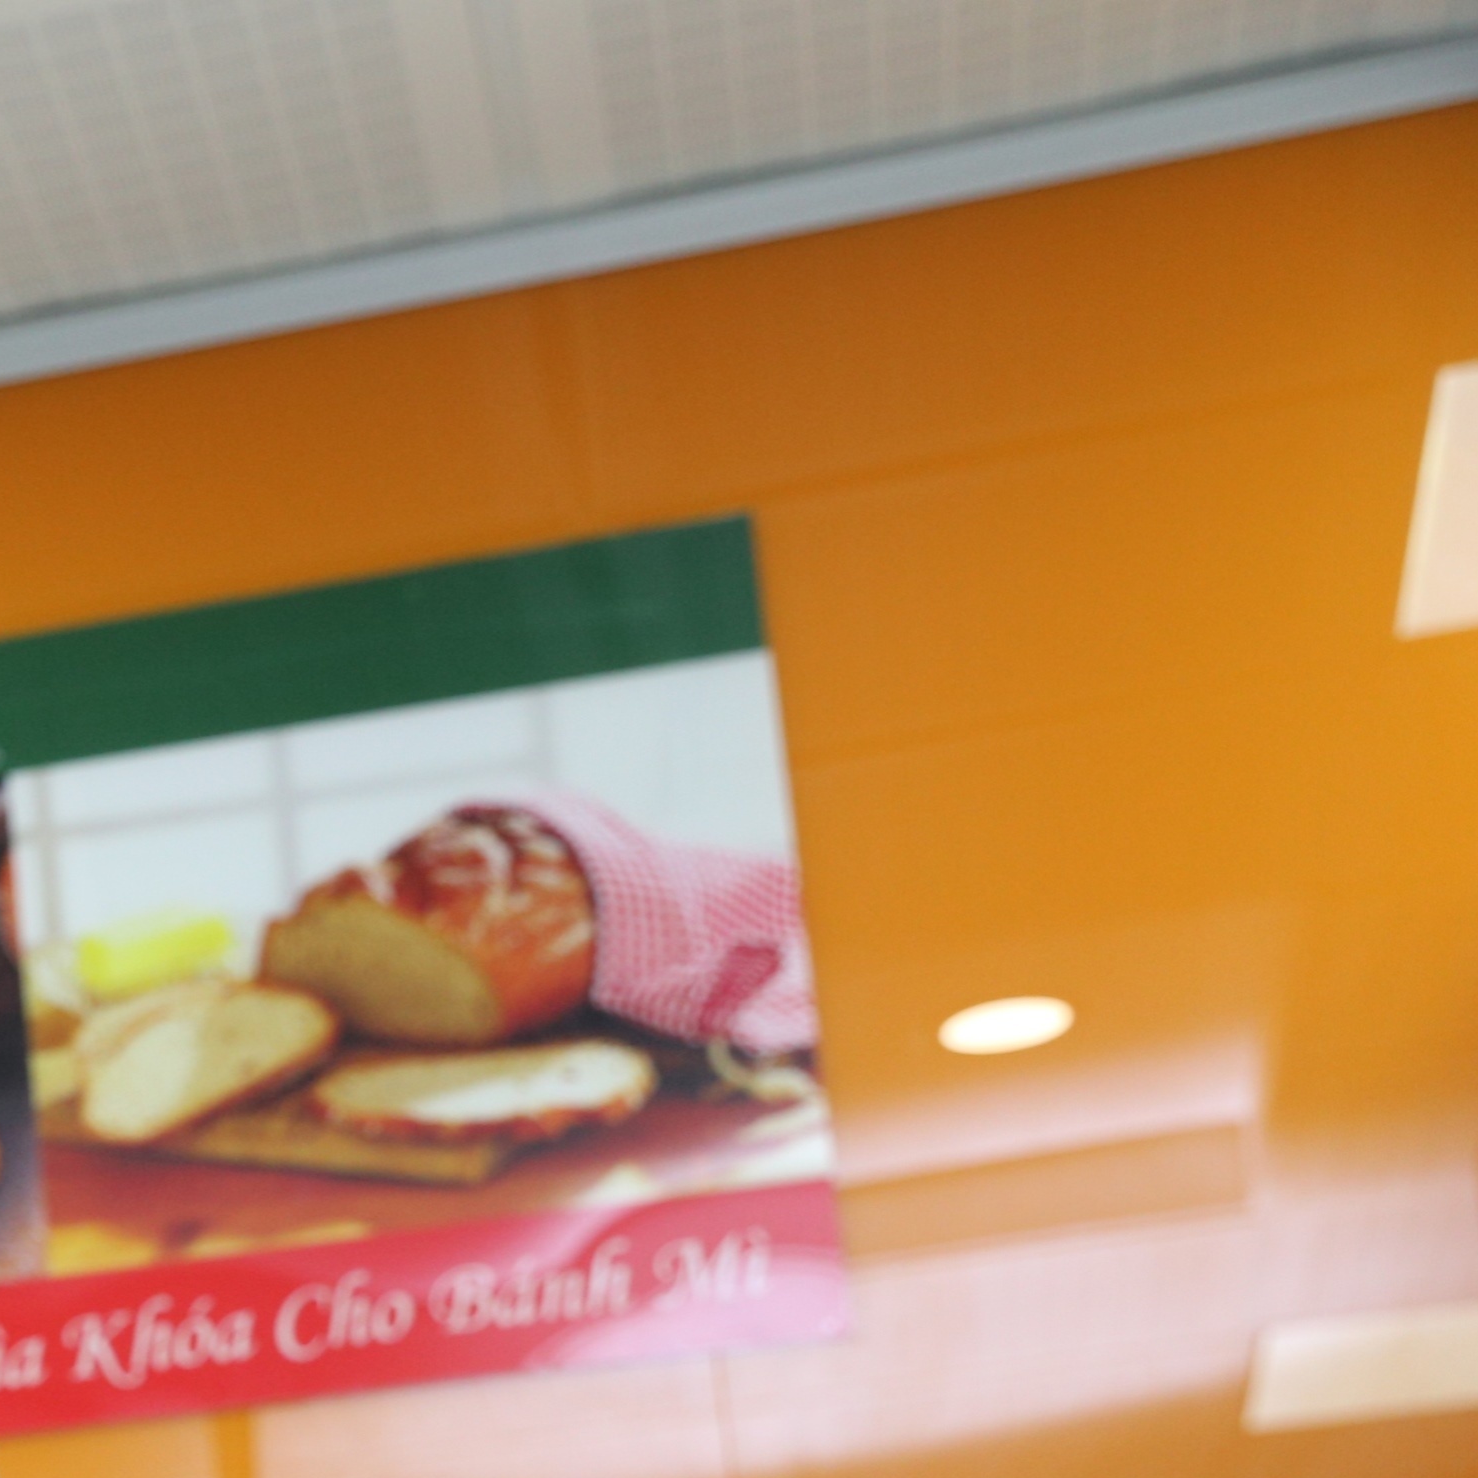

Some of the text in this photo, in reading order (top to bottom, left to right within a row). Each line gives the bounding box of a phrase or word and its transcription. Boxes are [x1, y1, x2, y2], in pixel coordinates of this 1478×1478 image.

[60, 1291, 255, 1390] Khóa
[271, 1266, 415, 1363] Cho
[428, 1238, 633, 1334] Bánh
